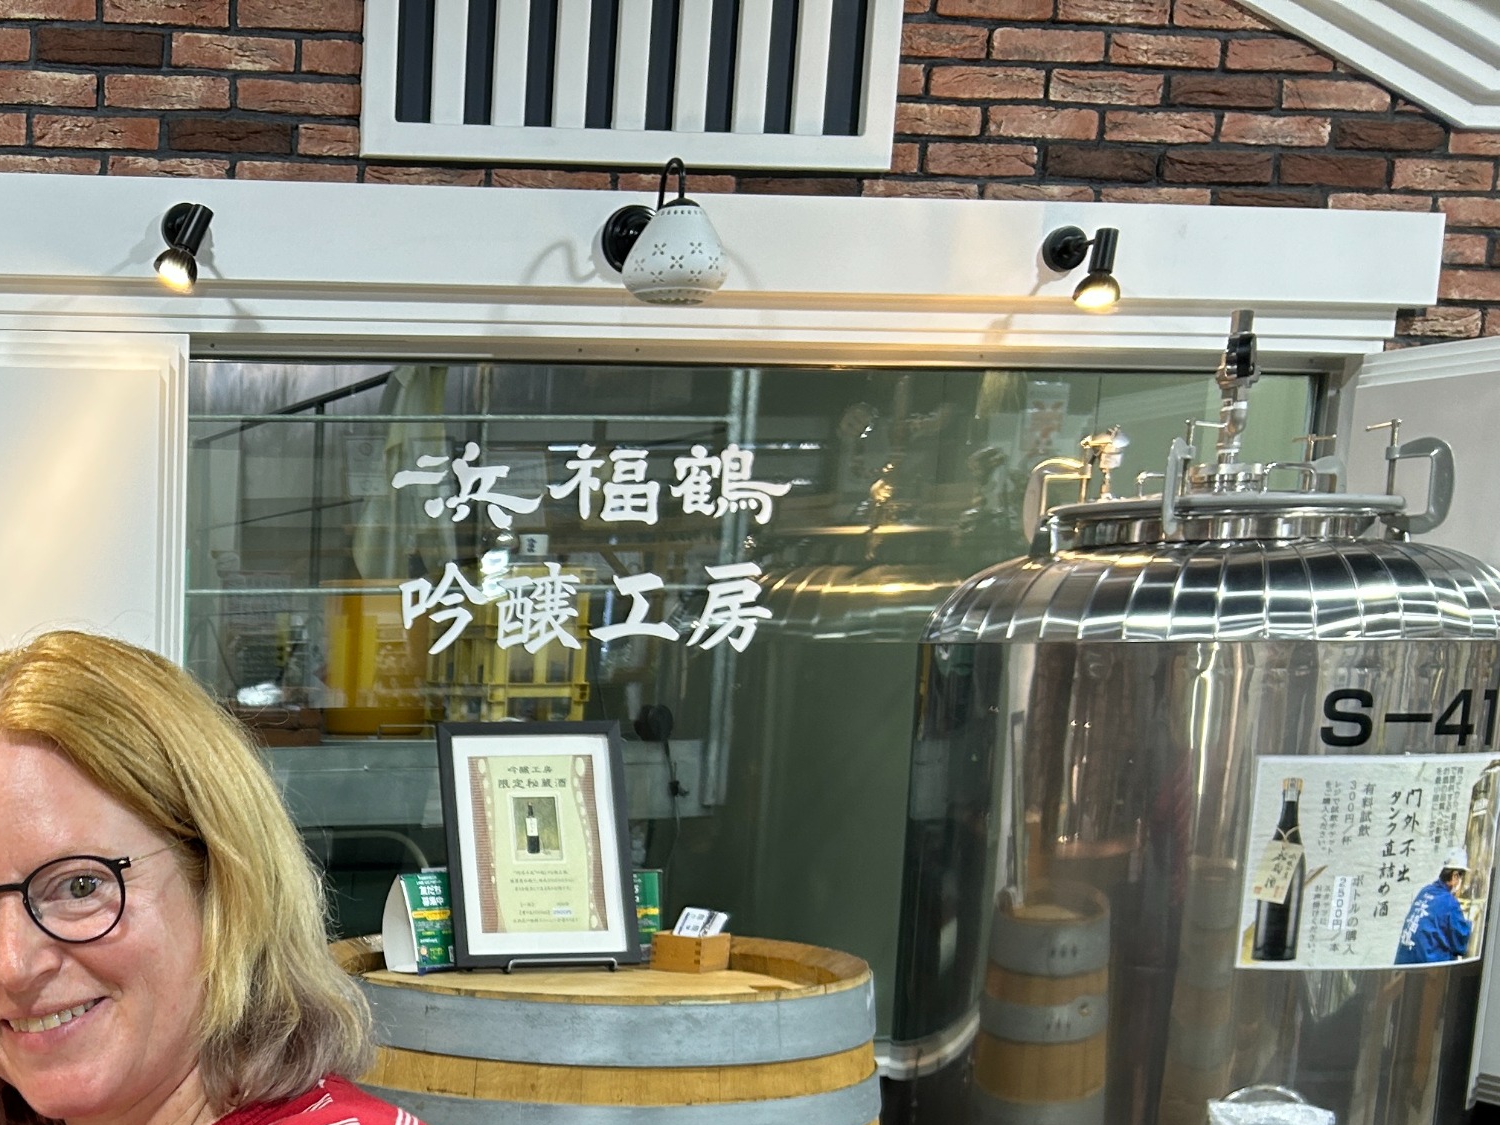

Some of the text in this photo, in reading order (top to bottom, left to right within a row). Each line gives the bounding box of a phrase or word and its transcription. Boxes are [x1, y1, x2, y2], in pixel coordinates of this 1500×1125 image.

[391, 441, 797, 529] 浜福鶴
[399, 561, 773, 655] 吟醸工房
[1358, 782, 1377, 837] 有料試飲
[1373, 790, 1401, 918] タンク直詰め酒
[1397, 788, 1422, 882] 門外不出
[1342, 874, 1365, 956] ボトルの購入
